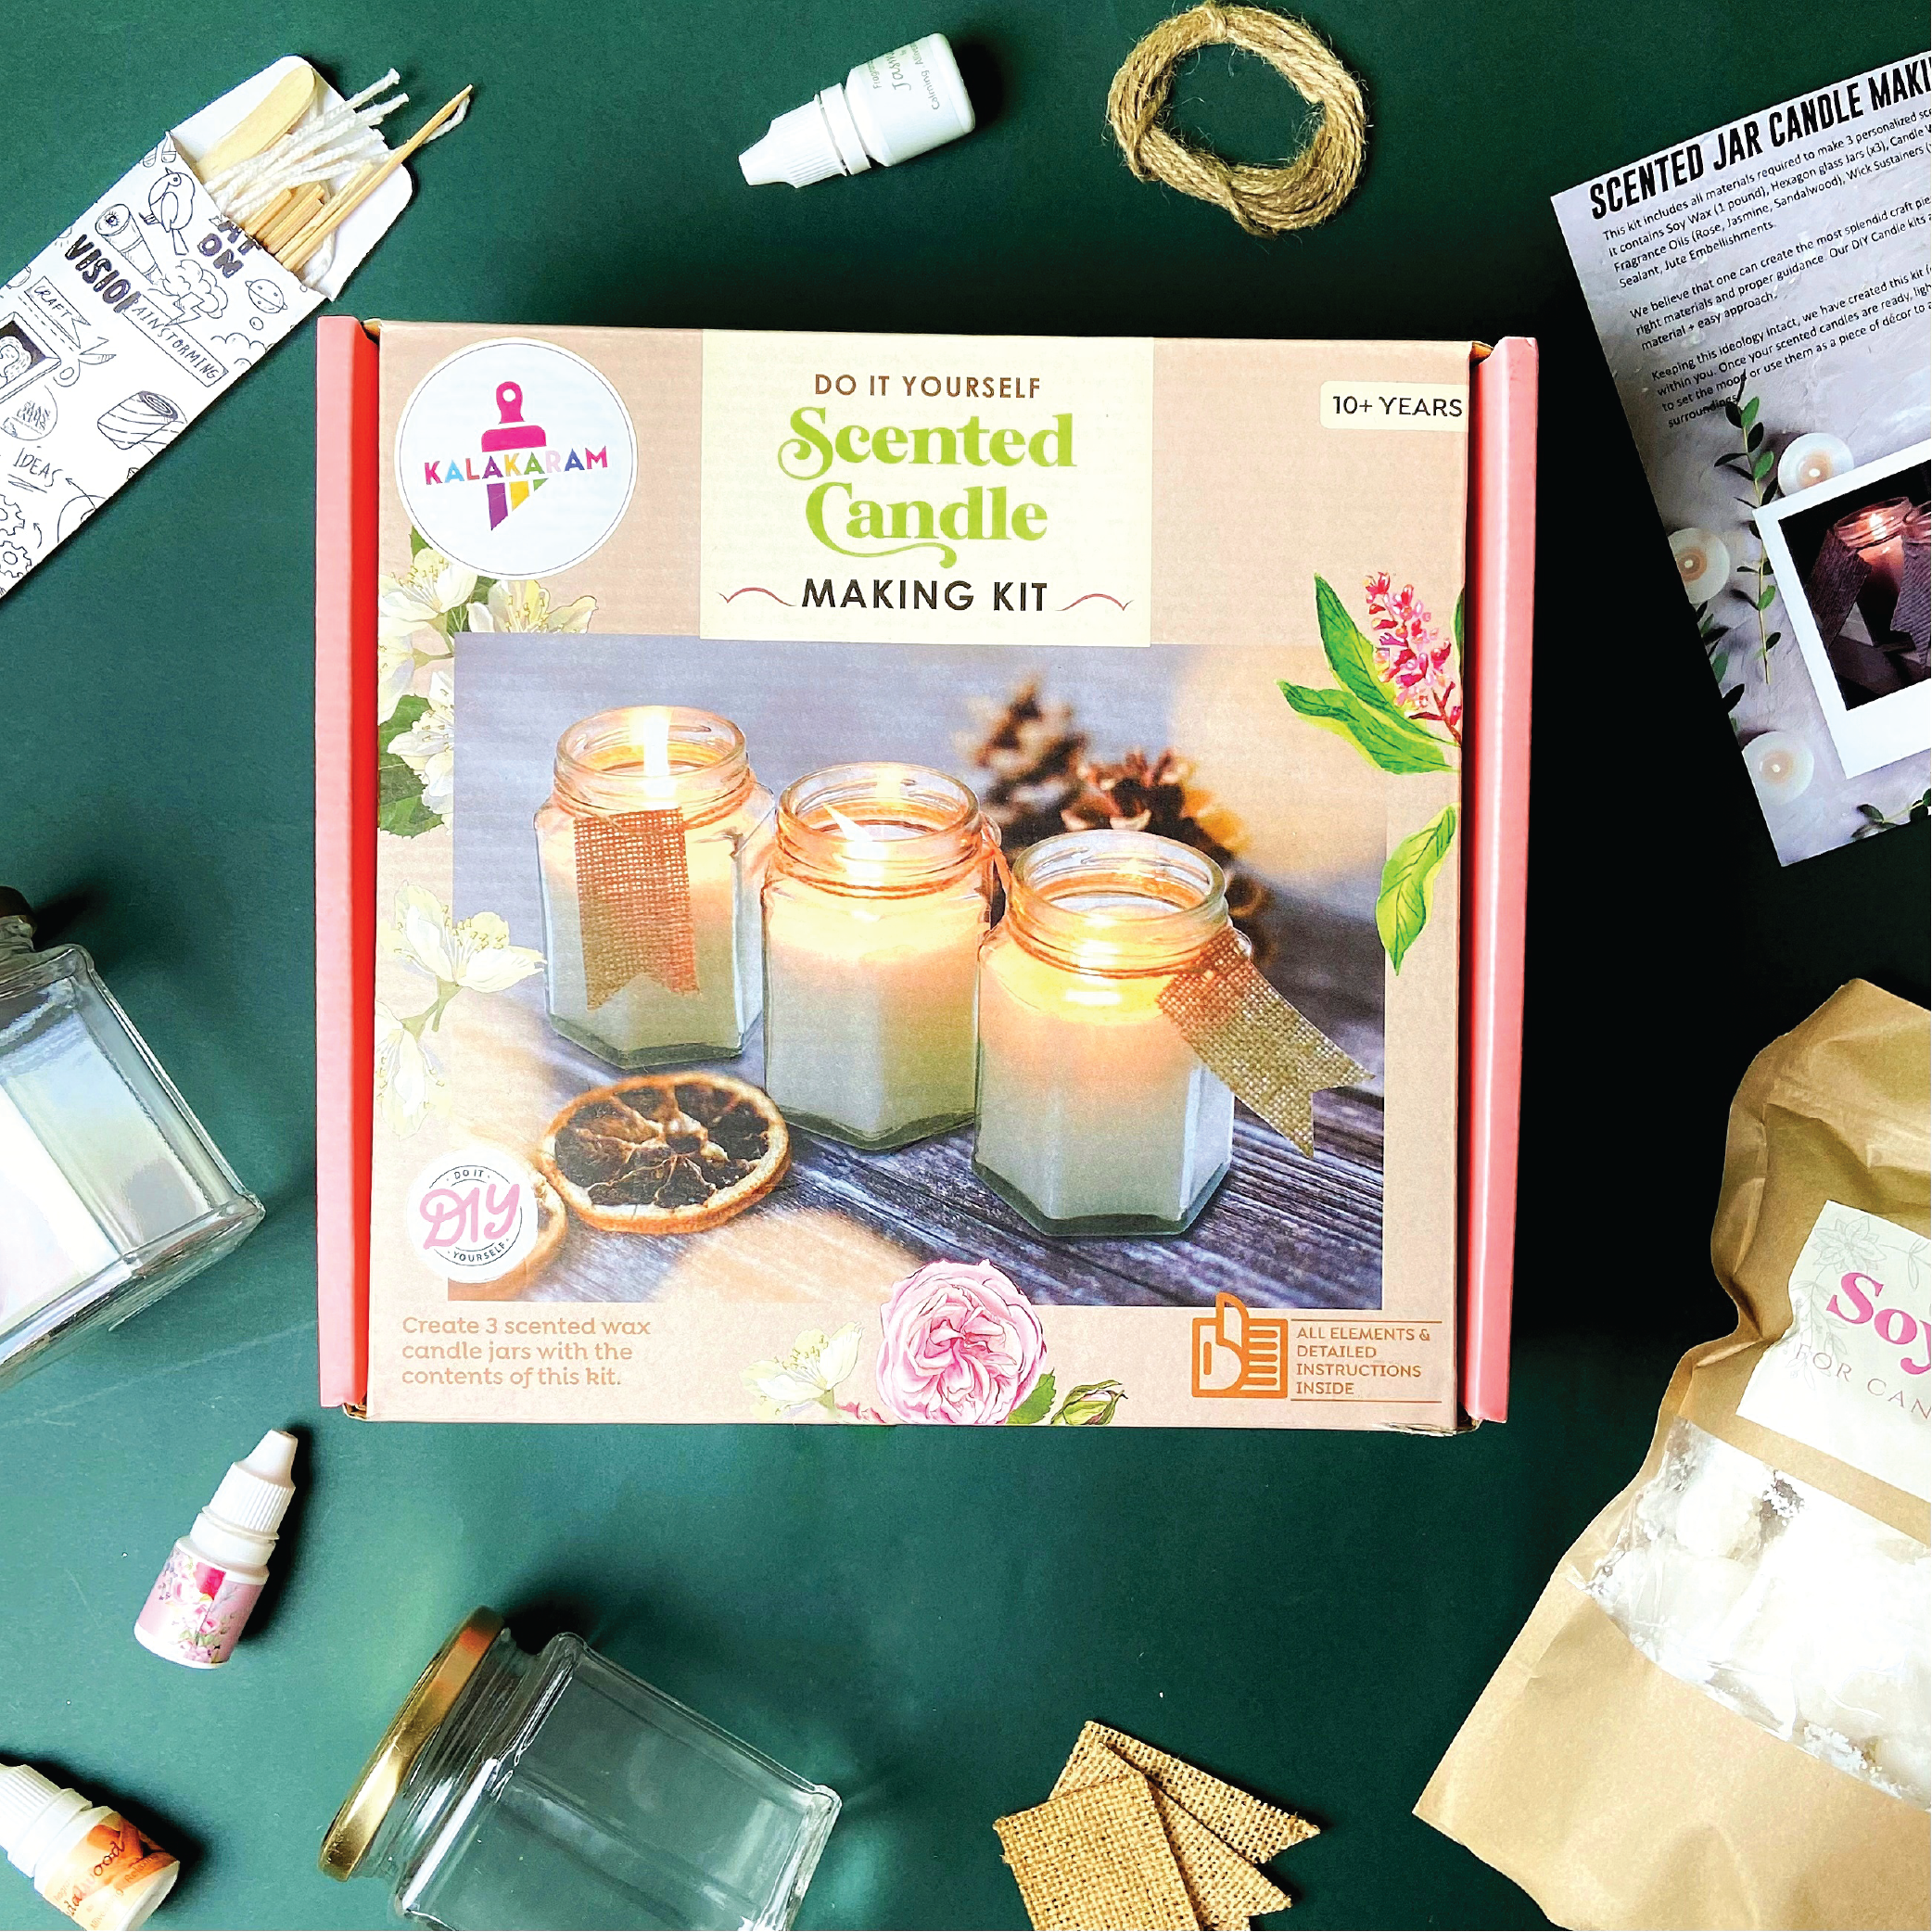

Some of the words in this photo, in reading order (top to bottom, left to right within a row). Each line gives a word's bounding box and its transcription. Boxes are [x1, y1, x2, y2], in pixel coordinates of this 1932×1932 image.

[921, 70, 941, 110] Calming
[1590, 144, 1704, 220] SCENTED
[1713, 121, 1763, 171] JAR
[1769, 83, 1863, 146] CANDLE
[1868, 57, 1931, 110] MAKI
[1601, 225, 1627, 242] This
[1625, 218, 1644, 233] kit
[1642, 199, 1690, 226] includes
[1689, 191, 1705, 207] all
[1705, 172, 1756, 201] materials
[1756, 153, 1802, 182] required
[1801, 150, 1816, 162] to
[1816, 139, 1846, 157] make
[1845, 133, 1855, 146] 3
[1854, 110, 1918, 146] personalized
[1608, 247, 1619, 259] It
[1619, 228, 1666, 254] contains
[1664, 218, 1686, 235] Soy
[1686, 209, 1713, 225] Wax
[1712, 201, 1726, 217] (1
[1769, 168, 1818, 193] Hexagon
[1817, 157, 1845, 177] glass
[1844, 149, 1866, 165] Jars
[1888, 127, 1926, 147] Candle
[1612, 245, 1668, 275] Fragrance
[1667, 235, 1691, 251] Oils
[1844, 162, 1874, 181] Wick
[1872, 145, 1926, 172] Sustainers
[197, 233, 245, 279] ON
[1628, 304, 1651, 321] We
[1647, 289, 1691, 313] believe
[1690, 278, 1716, 296] that
[1715, 271, 1738, 286] one
[1738, 261, 1760, 277] can
[1760, 248, 1795, 269] create
[1794, 240, 1815, 255] the
[1815, 228, 1844, 247] most
[1843, 209, 1889, 236] splendid
[1888, 200, 1915, 218] craft
[1634, 314, 1664, 337] right
[1658, 297, 1714, 325] materials
[1714, 286, 1736, 306] and
[1735, 273, 1774, 298] proper
[1828, 243, 1849, 259] Our
[1850, 234, 1869, 251] DIY
[1870, 222, 1907, 243] Candle
[1906, 214, 1927, 229] kits
[1663, 254, 1688, 272] Jute
[33, 285, 73, 318] CRAFT
[131, 306, 220, 380] AINSTORMING
[1640, 324, 1687, 351] material
[1697, 311, 1724, 330] easy
[1650, 357, 1697, 382] Keeping
[1695, 350, 1719, 365] this
[1717, 330, 1767, 357] ideology
[1800, 310, 1820, 323] we
[1818, 299, 1848, 316] have
[1847, 280, 1888, 306] created
[1888, 273, 1911, 289] this
[1909, 268, 1926, 282] kit
[1657, 375, 1693, 397] within
[1717, 351, 1748, 374] Once
[1747, 344, 1774, 363] your
[1773, 324, 1818, 352] scented
[1818, 311, 1861, 335] candles
[1860, 304, 1880, 318] are
[1661, 401, 1675, 413] to
[1675, 392, 1695, 408] set
[1694, 386, 1714, 400] the
[1748, 366, 1762, 379] or
[1762, 359, 1784, 374] use
[1783, 345, 1814, 366] them
[1814, 341, 1829, 353] as
[1828, 337, 1837, 349] a
[1837, 326, 1868, 347] piece
[1868, 317, 1881, 333] of
[1881, 308, 1913, 327] décor
[1913, 303, 1926, 315] to
[815, 374, 857, 396] DO
[870, 375, 890, 397] IT
[903, 375, 1041, 399] YOURSELF
[1332, 395, 1373, 414] 10+
[1379, 396, 1463, 418] YEARS
[778, 406, 1077, 480] Scented
[12, 447, 64, 488] IDEAS
[424, 445, 608, 486] KALAKARAM
[806, 481, 1048, 569] Candle
[801, 578, 974, 612] MAKING
[994, 581, 1048, 613] KIT
[453, 1169, 470, 1180] DO
[473, 1169, 485, 1178] IT
[419, 1183, 520, 1250] DIY
[453, 1241, 505, 1262] YOURSELF
[402, 1316, 479, 1335] Create
[485, 1317, 498, 1335] 3
[504, 1316, 596, 1335] scented
[601, 1320, 651, 1336] wax
[1296, 1327, 1325, 1340] ALL
[1330, 1327, 1415, 1341] ELEMENTS
[1419, 1328, 1430, 1341] &
[401, 1341, 482, 1360] candle
[488, 1341, 531, 1364] jars
[536, 1341, 588, 1360] with
[594, 1341, 632, 1360] the
[1296, 1363, 1422, 1378] INSTRUCTIONS
[1297, 1345, 1377, 1359] DETAILED
[1796, 1344, 1852, 1382] FOR
[401, 1367, 503, 1386] contents
[510, 1367, 534, 1389] of
[538, 1366, 579, 1386] this
[586, 1367, 621, 1386] kit.
[1296, 1381, 1354, 1395] INSIDE
